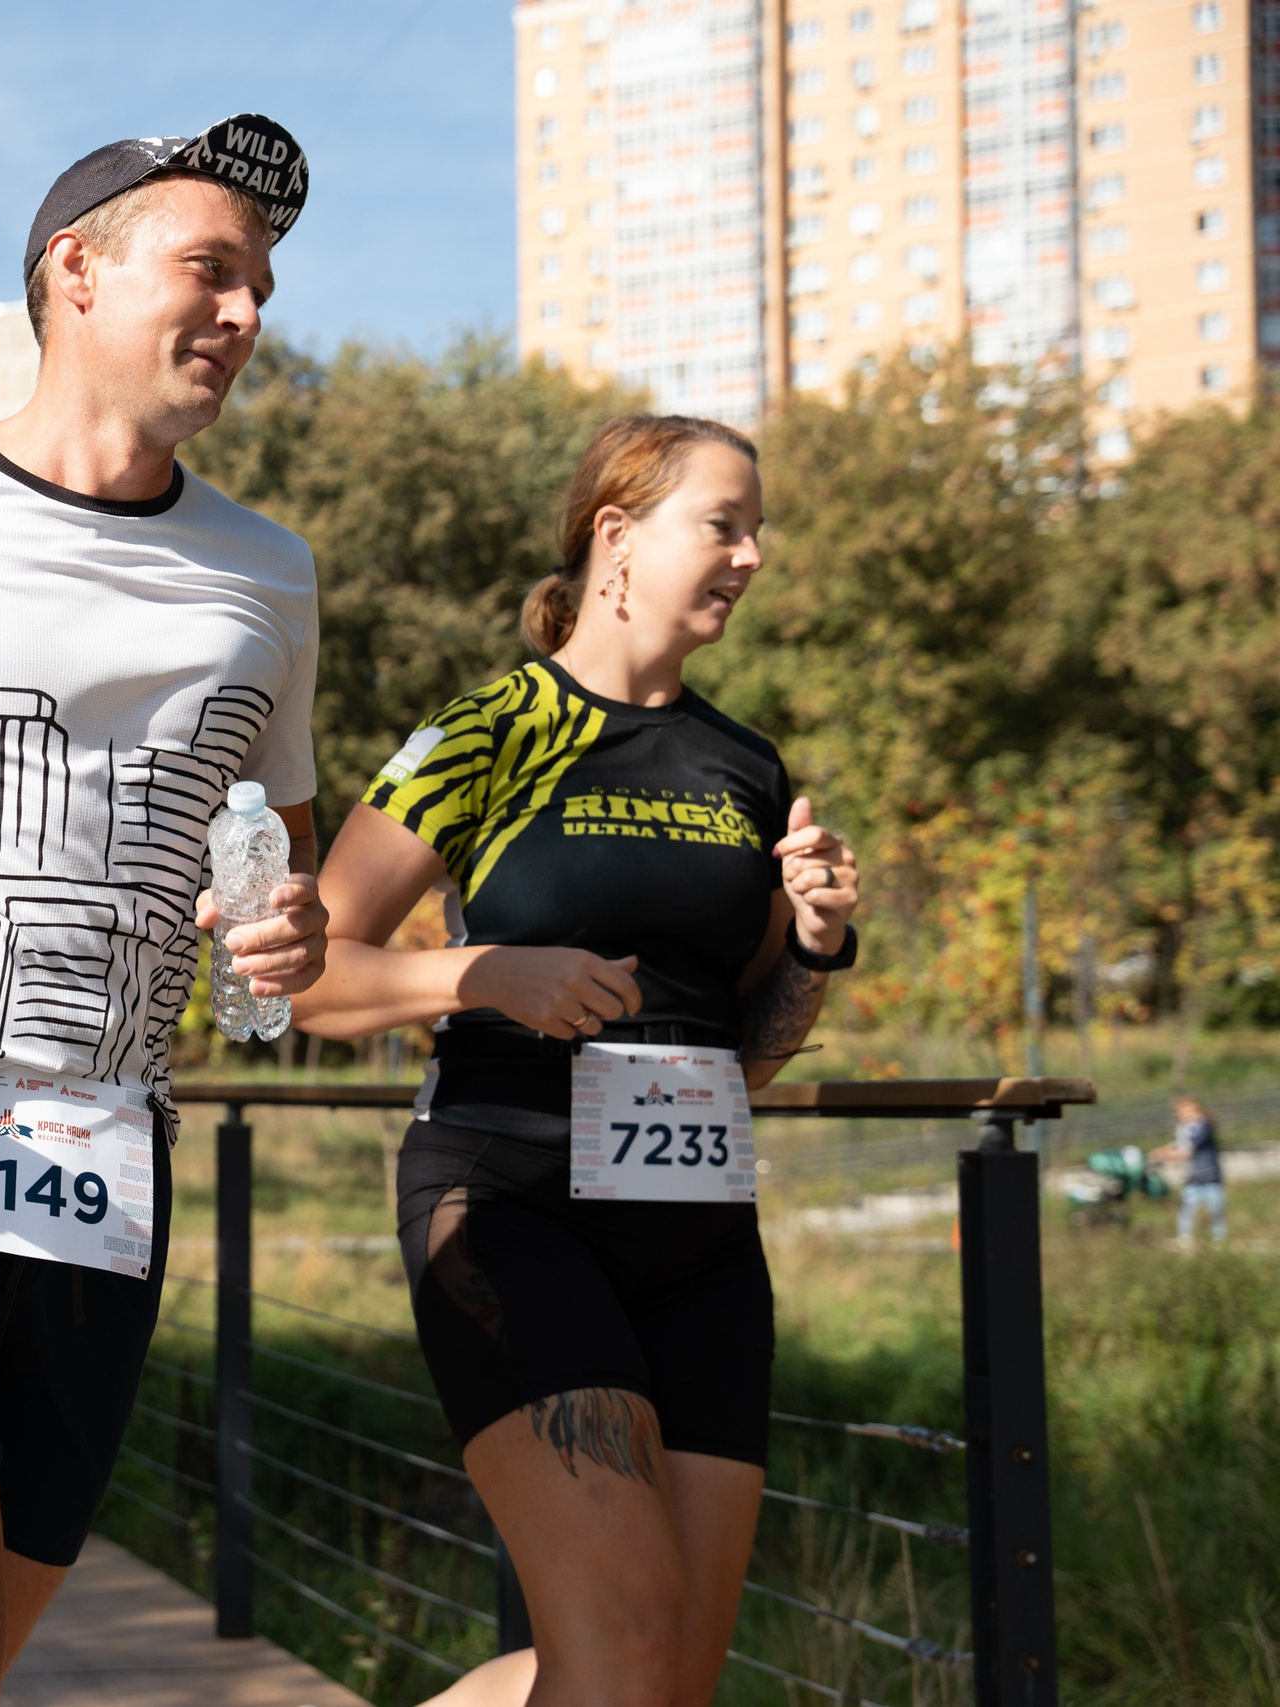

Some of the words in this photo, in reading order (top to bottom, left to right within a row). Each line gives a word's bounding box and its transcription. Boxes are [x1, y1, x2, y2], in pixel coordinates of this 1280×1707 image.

[225, 122, 288, 165] WILD
[215, 152, 281, 196] TRAIL
[591, 785, 718, 803] GOLDEN
[562, 794, 713, 827] RING
[563, 821, 658, 839] ULTRA
[37, 1134, 76, 1146] МОСКОВСКИЙ
[38, 1120, 65, 1135] КРОСС
[66, 1125, 91, 1141] НАЦИИ
[610, 1122, 728, 1167] 7233
